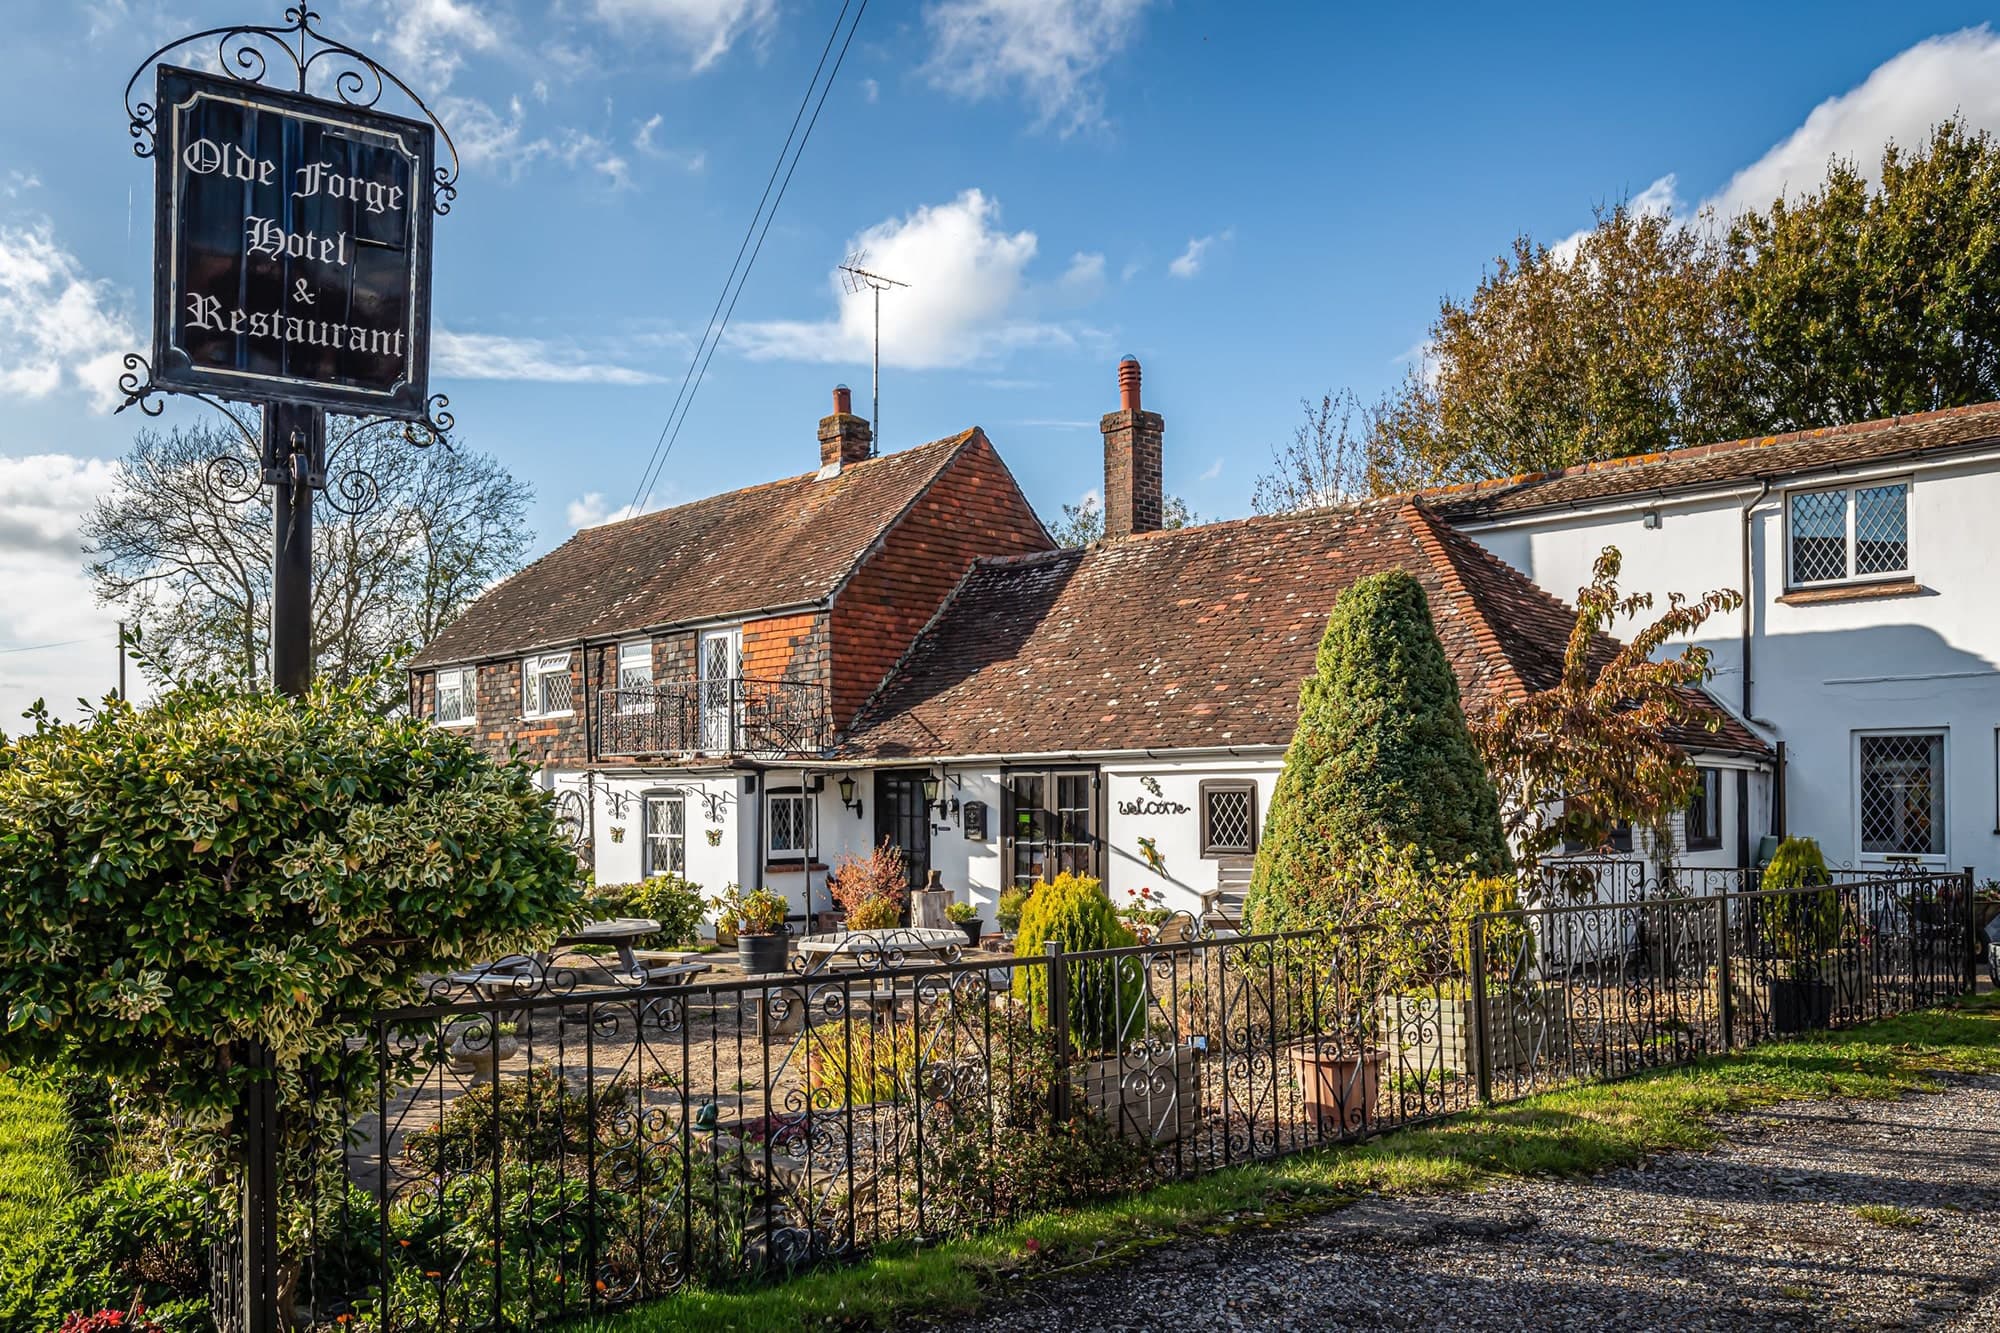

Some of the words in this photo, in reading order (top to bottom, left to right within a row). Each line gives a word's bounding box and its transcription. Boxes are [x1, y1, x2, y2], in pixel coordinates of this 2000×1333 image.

[183, 138, 276, 186] Olde
[291, 161, 404, 214] Forge
[245, 215, 347, 266] Hotel
[292, 277, 316, 305] &
[185, 292, 405, 357] Restaurant
